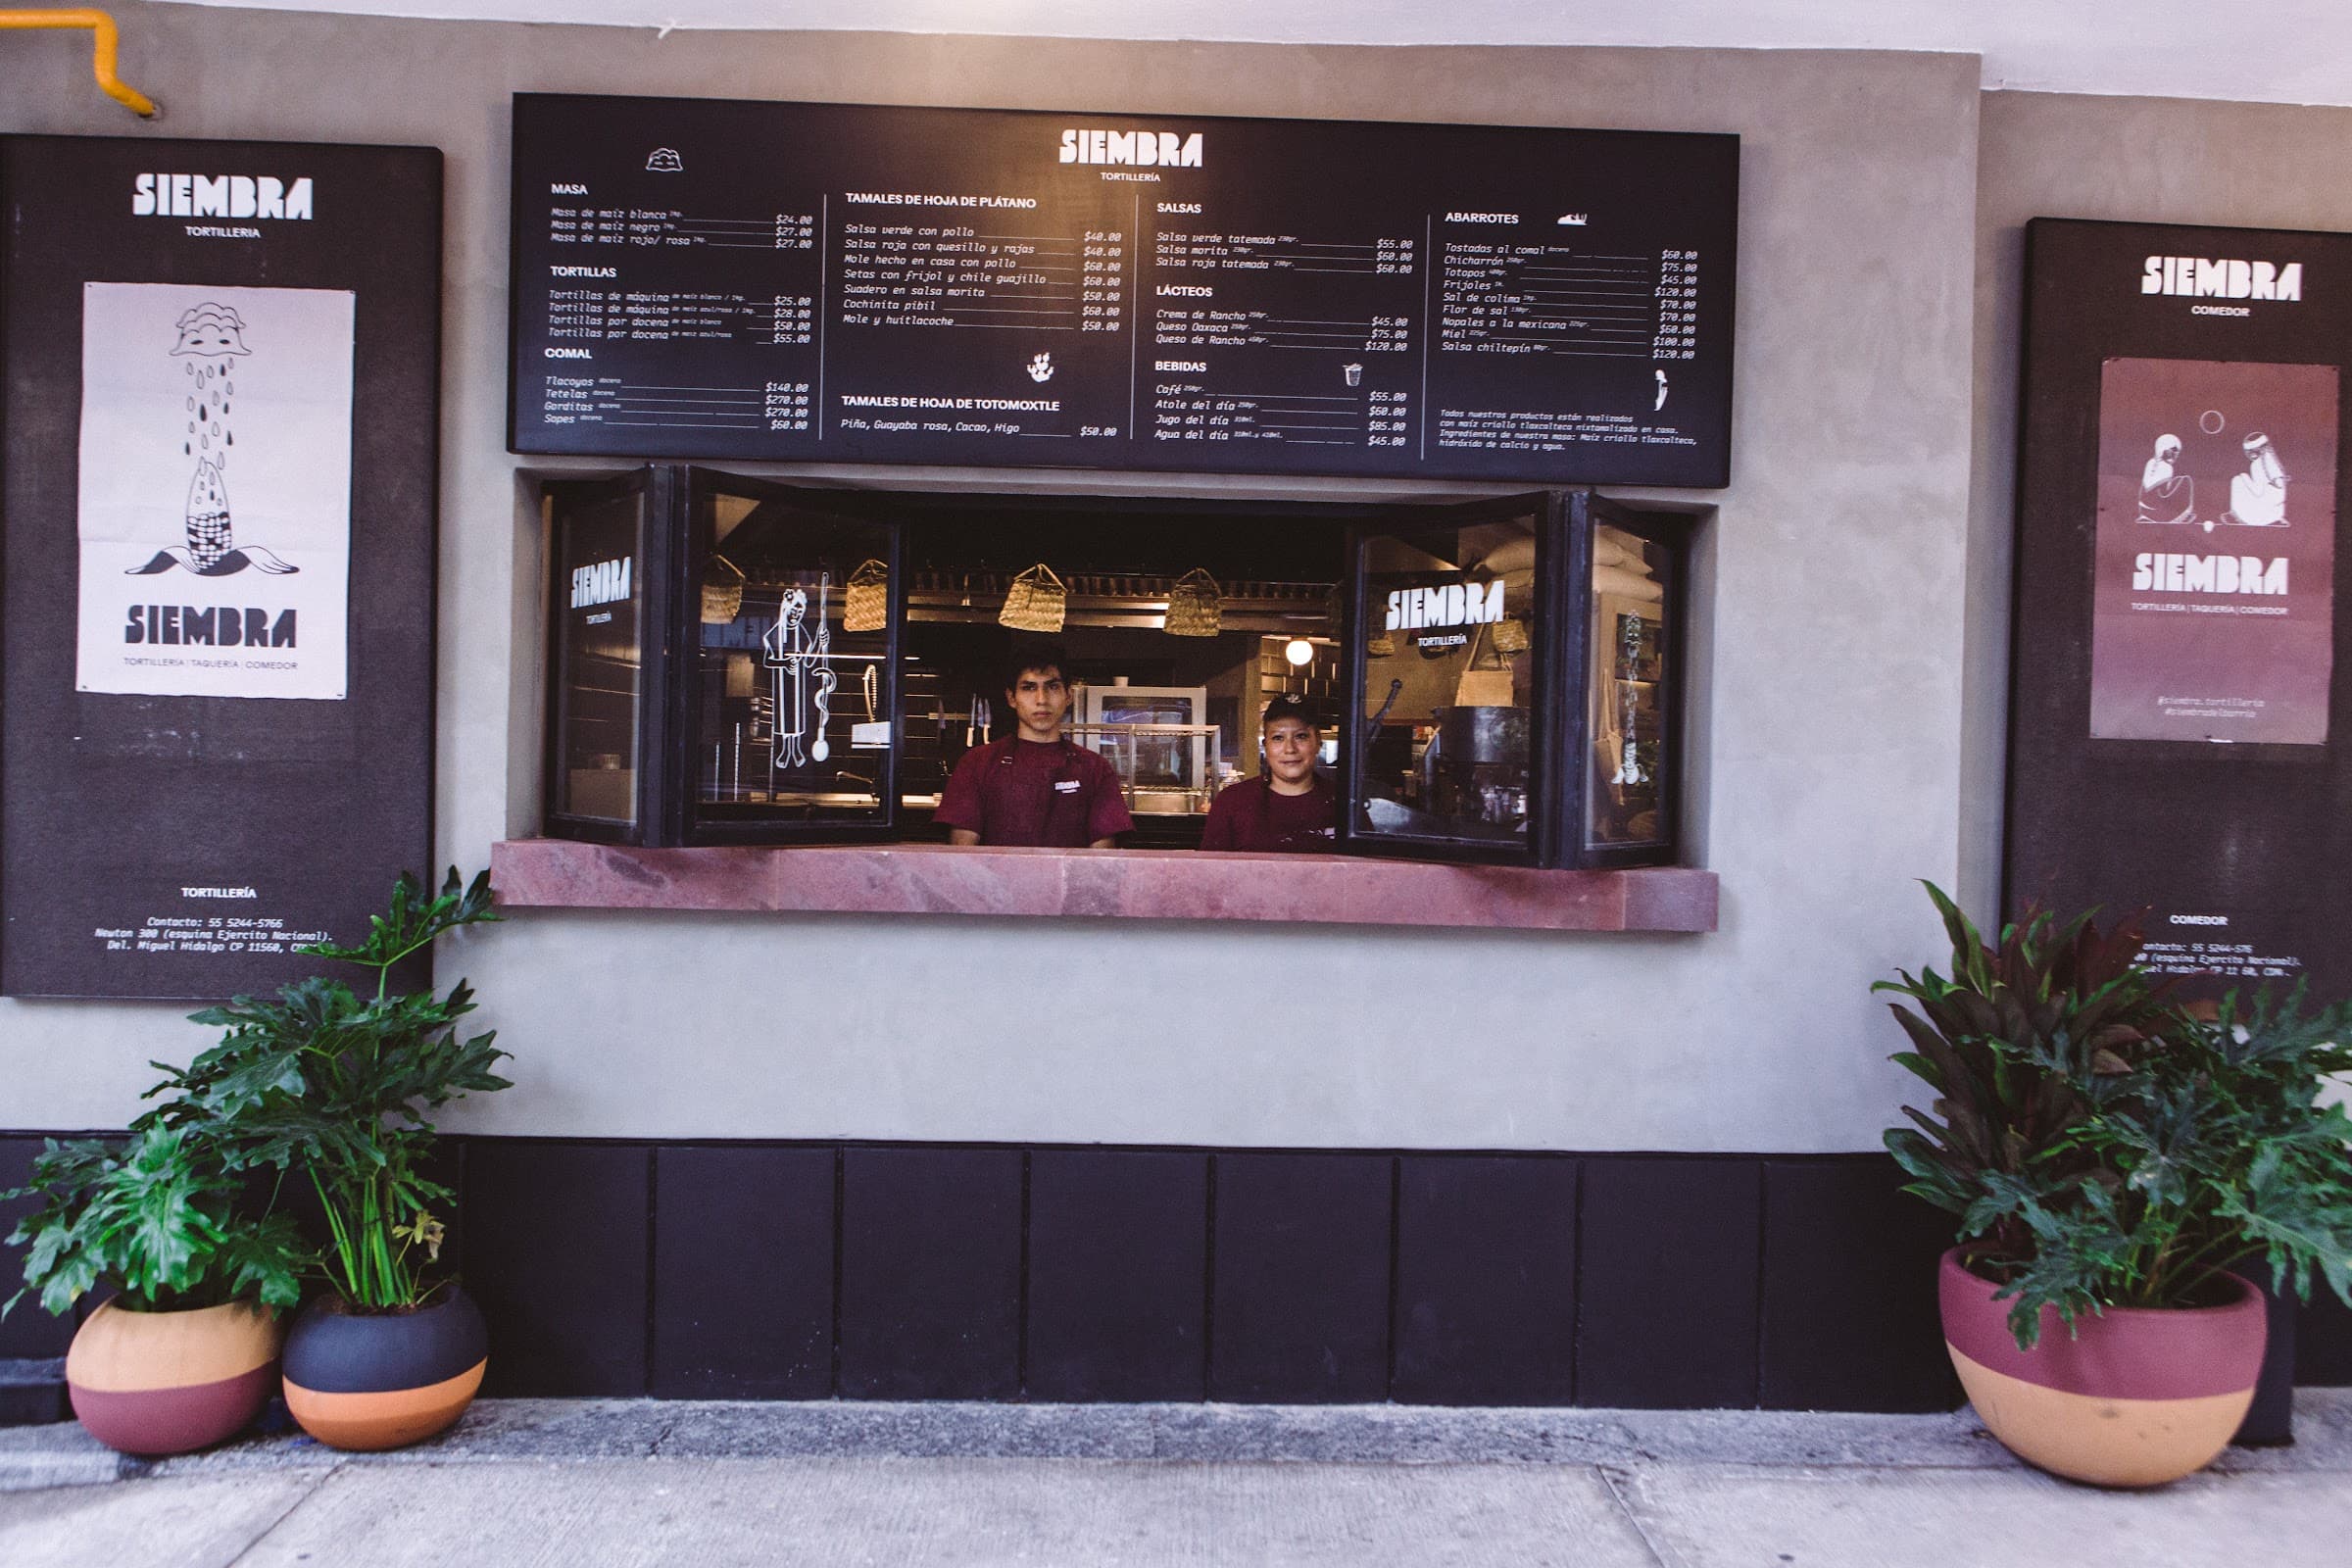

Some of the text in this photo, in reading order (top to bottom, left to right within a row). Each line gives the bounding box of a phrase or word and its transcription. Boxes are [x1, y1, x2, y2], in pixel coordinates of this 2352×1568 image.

[1059, 129, 1203, 168] SIEMBRA
[1100, 172, 1161, 182] TORTILLERÍA
[133, 173, 313, 220] SIEMBRA
[551, 183, 588, 195] MASA
[845, 192, 1037, 209] TAMALES DE HOJA DE PLÁTANO
[1156, 202, 1201, 214] SALSAS
[551, 208, 576, 217] Masa
[581, 208, 595, 218] de
[629, 209, 667, 220] blanca
[775, 214, 812, 225] $24.00
[1445, 212, 1519, 224] ABARROTES
[845, 223, 876, 233] Salsa
[882, 225, 913, 235] verde
[942, 226, 974, 237] pollo
[1084, 230, 1122, 242] $40.00
[1155, 231, 1413, 249] Salsa verde tatemada $55.00
[844, 238, 1121, 257] Salsa roja con quesillo y rajas $40.00
[1155, 244, 1413, 262] Salsa morita $60.00
[1446, 243, 1698, 261] Tostadas al comal $60.00
[550, 266, 616, 277] TORTILLAS
[1444, 255, 1697, 272] Chicharrón $75.00
[844, 269, 875, 278] Setas
[904, 270, 942, 282] frijol
[947, 274, 955, 283] y
[959, 271, 992, 282] chile
[996, 273, 1047, 285] guajillo
[1082, 275, 1121, 287] $60.00
[1445, 268, 1697, 285] Totopos $45.00
[2141, 256, 2302, 301] SIEMBRA
[1156, 284, 1212, 297] LÁCTEOS
[1443, 279, 1697, 297] Frijoles $120.00
[550, 289, 604, 300] Tortillas
[608, 291, 621, 301] de
[773, 295, 811, 307] $25.00
[843, 299, 1120, 317] Cochinita pibil $60.00
[2191, 305, 2250, 317] COMEDOR
[549, 315, 810, 331] Tortillas por docena $50.00
[843, 314, 1120, 331] Mole y huitlacoche $50.00
[1156, 309, 1408, 326] Crema de Rancho $45.00
[1442, 317, 1485, 327] Nopales
[1502, 318, 1514, 328] la
[1518, 319, 1567, 329] mexicana
[1659, 323, 1695, 335] $60.00
[1155, 321, 1408, 339] Queso Oaxaca $75.00
[1442, 329, 1695, 347] Miel $100.00
[544, 348, 593, 359] COMAL
[1442, 341, 1695, 360] Salsa chiltepín $120.00
[1155, 361, 1206, 372] BEBIDAS
[546, 375, 809, 393] Tlacoyos $140.00
[546, 388, 808, 406] Tetelas $270.00
[1155, 384, 1407, 402] Café $55.00
[544, 401, 808, 417] Gorditas $270.00
[841, 395, 1059, 412] TAMALES DE HOJA DE TOTOMOXTLE
[1154, 399, 1406, 417] Atole del día $60.00
[544, 414, 808, 430] Sopes $60.00
[841, 418, 1117, 437] Piña, Guayaba rosa, Cacao, Higo $50.00
[1153, 429, 1406, 446] Agua del día $45.00
[570, 556, 631, 609] SIEMBRA
[2132, 553, 2289, 595] SIEMBRA
[1386, 579, 1504, 630] SIEMBRA
[125, 605, 297, 648] SIEMBRA
[1417, 633, 1467, 647] TORTILLERÍA
[245, 661, 298, 670] COMEDOR
[180, 886, 257, 899] TORTILLERÍA
[147, 916, 203, 927] Contacto:
[208, 917, 222, 927] 55
[2170, 914, 2229, 925] COMEDOR
[163, 929, 213, 940] (esquina
[107, 940, 131, 950] Del.
[137, 941, 175, 952] Miguel
[180, 940, 225, 953] Hidalgo
[228, 942, 244, 952] CP
